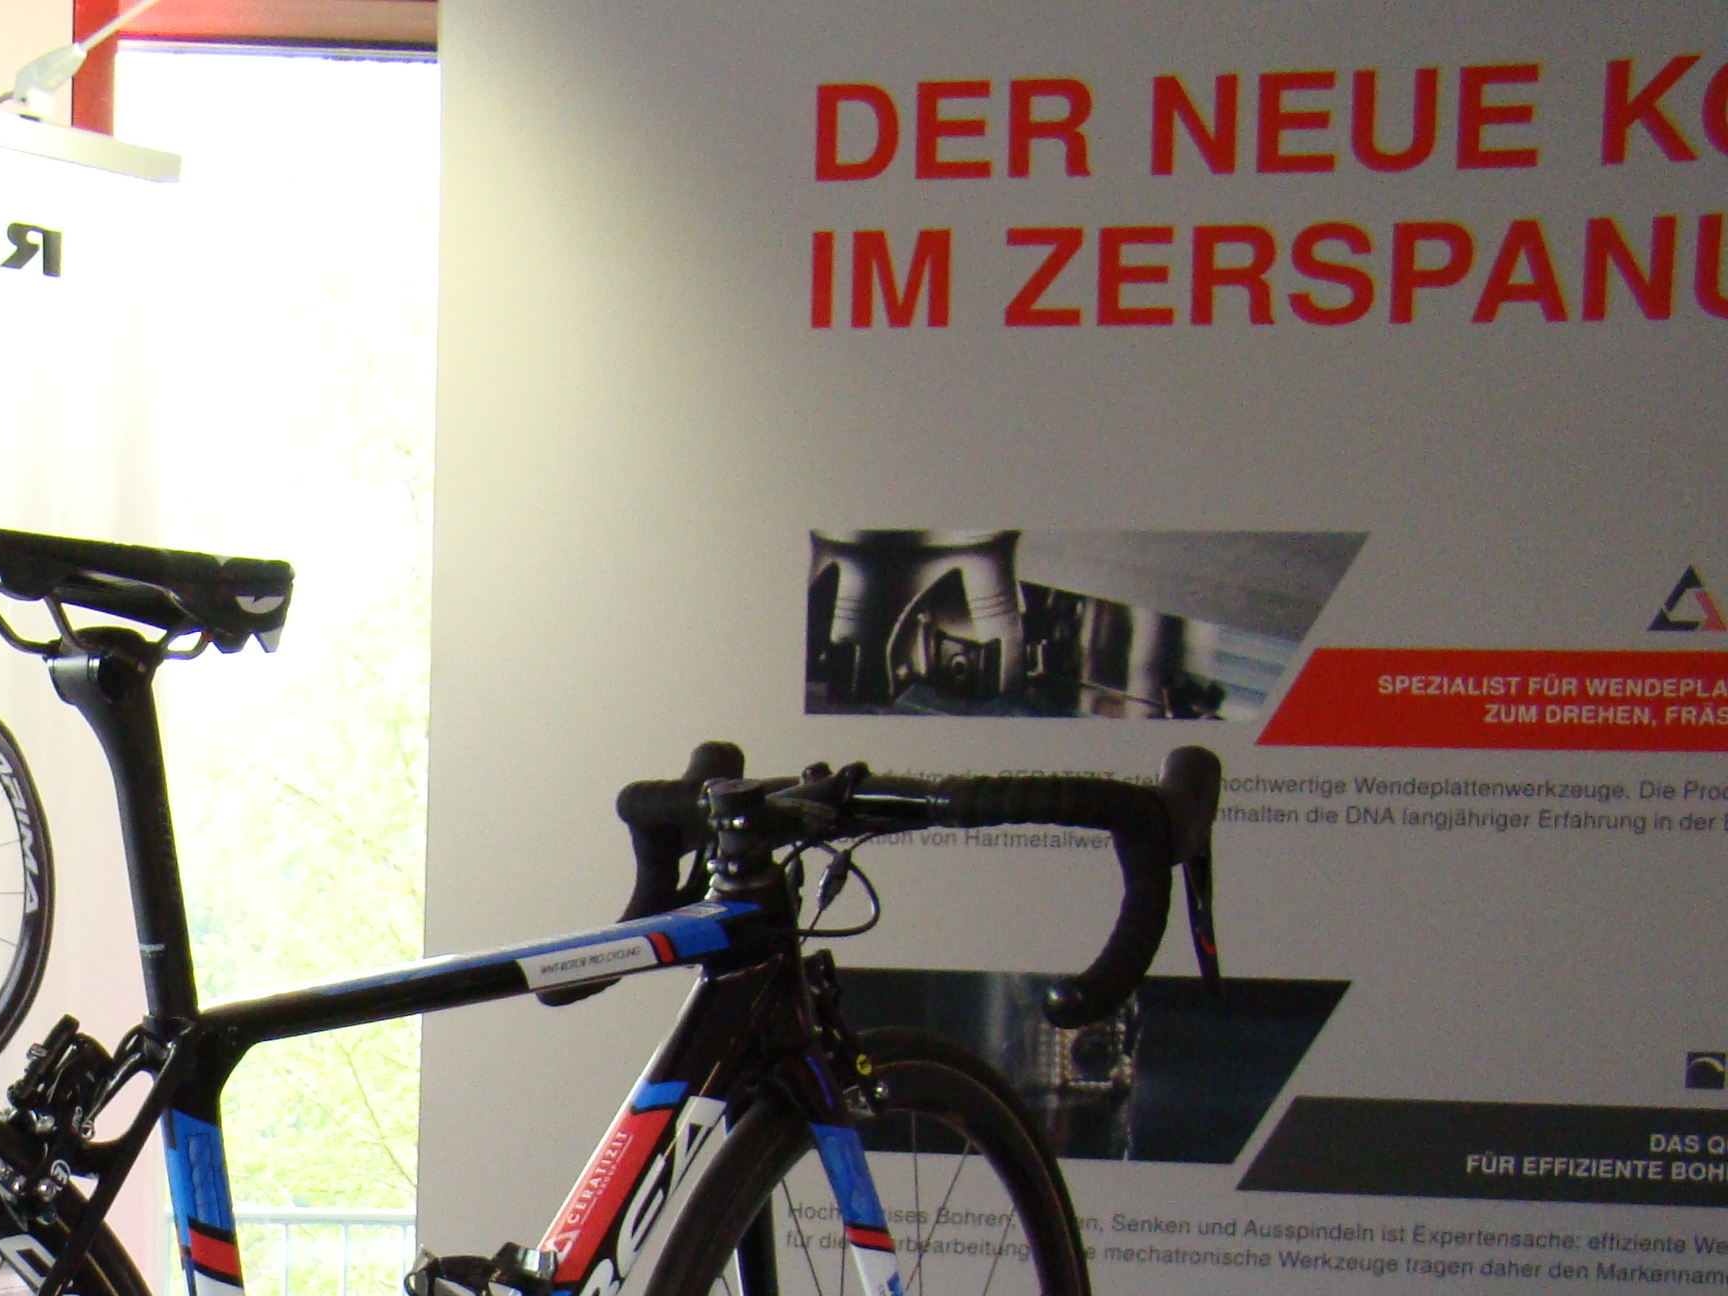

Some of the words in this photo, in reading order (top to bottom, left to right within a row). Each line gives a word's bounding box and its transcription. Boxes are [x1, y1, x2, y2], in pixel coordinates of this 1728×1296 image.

[815, 77, 1094, 182] DER
[1150, 63, 1542, 176] NEUE
[810, 228, 952, 330] IM
[1377, 675, 1521, 696] SPEZIALIST
[1528, 673, 1578, 696] FÜR
[1483, 704, 1538, 724] ZUM
[1545, 705, 1657, 728] DREHEN,
[1639, 780, 1675, 800] Die
[1217, 805, 1299, 824] nthalten
[1307, 806, 1338, 825] die
[1346, 806, 1395, 826] DNA
[1402, 806, 1531, 834] langjähriger
[1539, 809, 1646, 835] Erfahrung
[1654, 812, 1672, 831] in
[1679, 812, 1716, 831] der
[920, 831, 957, 847] von
[1649, 1134, 1700, 1154] DAS
[567, 1131, 628, 1225] CERATIZIT
[1466, 1151, 1514, 1176] FÜR
[1523, 1156, 1665, 1180] EFFIZIENTE
[1111, 1213, 1190, 1234] Senken
[1198, 1219, 1236, 1237] und
[1244, 1219, 1375, 1244] Ausspindeln
[1381, 1225, 1405, 1243] ist
[1587, 1232, 1687, 1254] effiziente
[1104, 1245, 1271, 1268] mechatronische
[1279, 1252, 1399, 1277] Werkzeuge
[1406, 1257, 1473, 1278] tragen
[1480, 1258, 1542, 1280] daher
[1549, 1261, 1589, 1281] den
